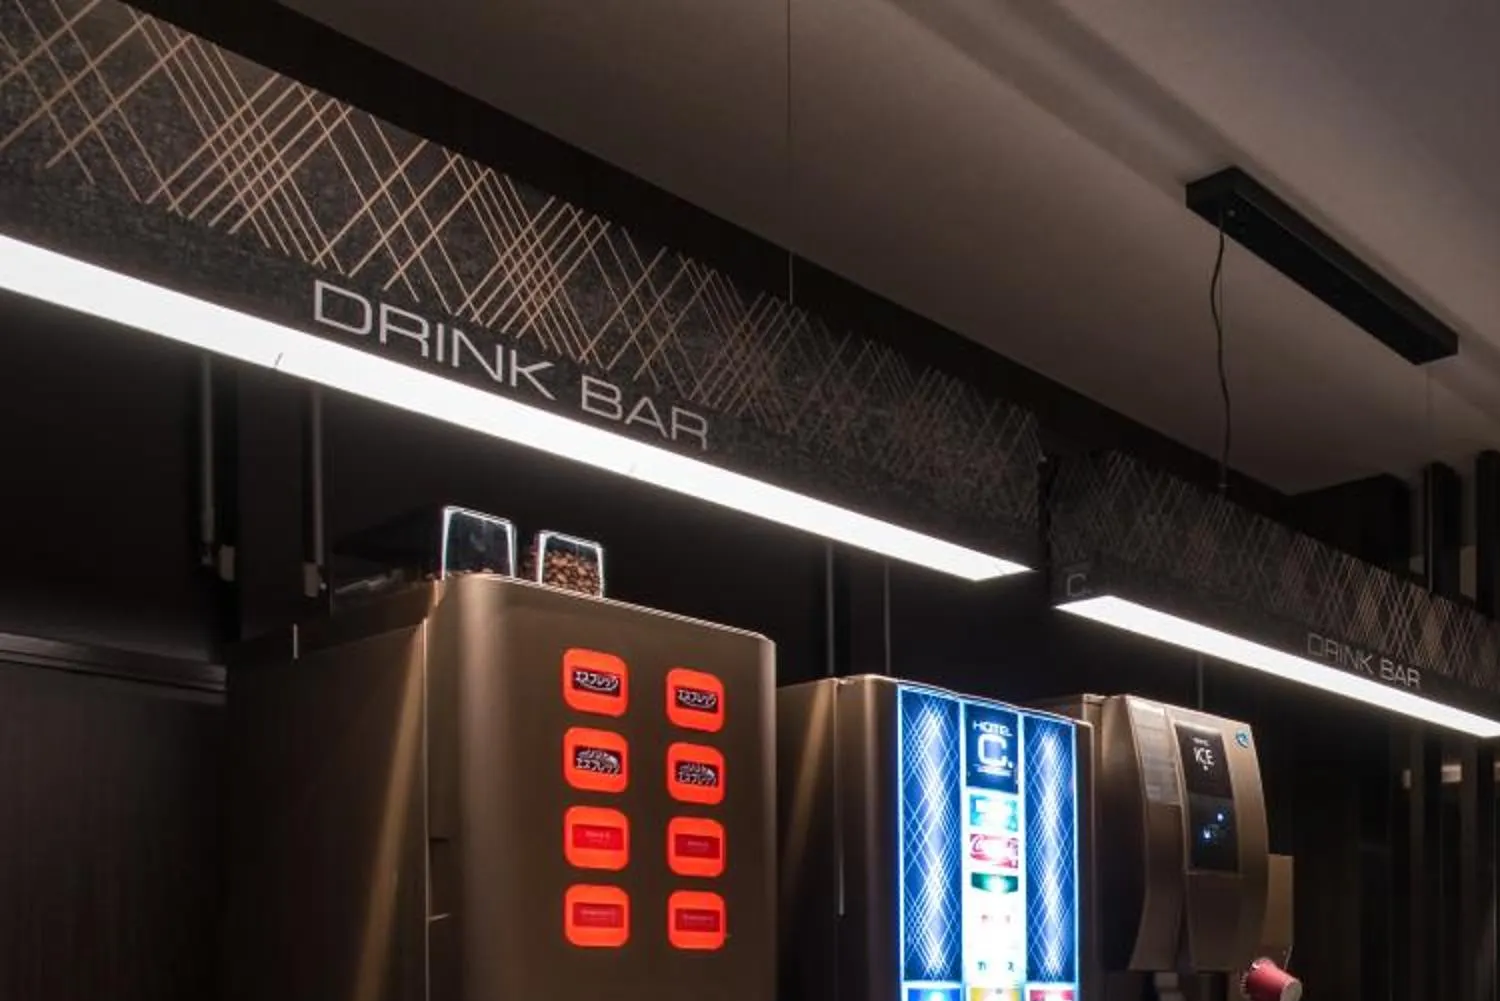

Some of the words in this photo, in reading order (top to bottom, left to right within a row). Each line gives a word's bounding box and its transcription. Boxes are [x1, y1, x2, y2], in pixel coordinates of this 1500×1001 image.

[313, 279, 557, 400] DRINK
[580, 374, 709, 451] BAR
[1307, 632, 1375, 675] DRINK
[1380, 657, 1421, 689] BAR
